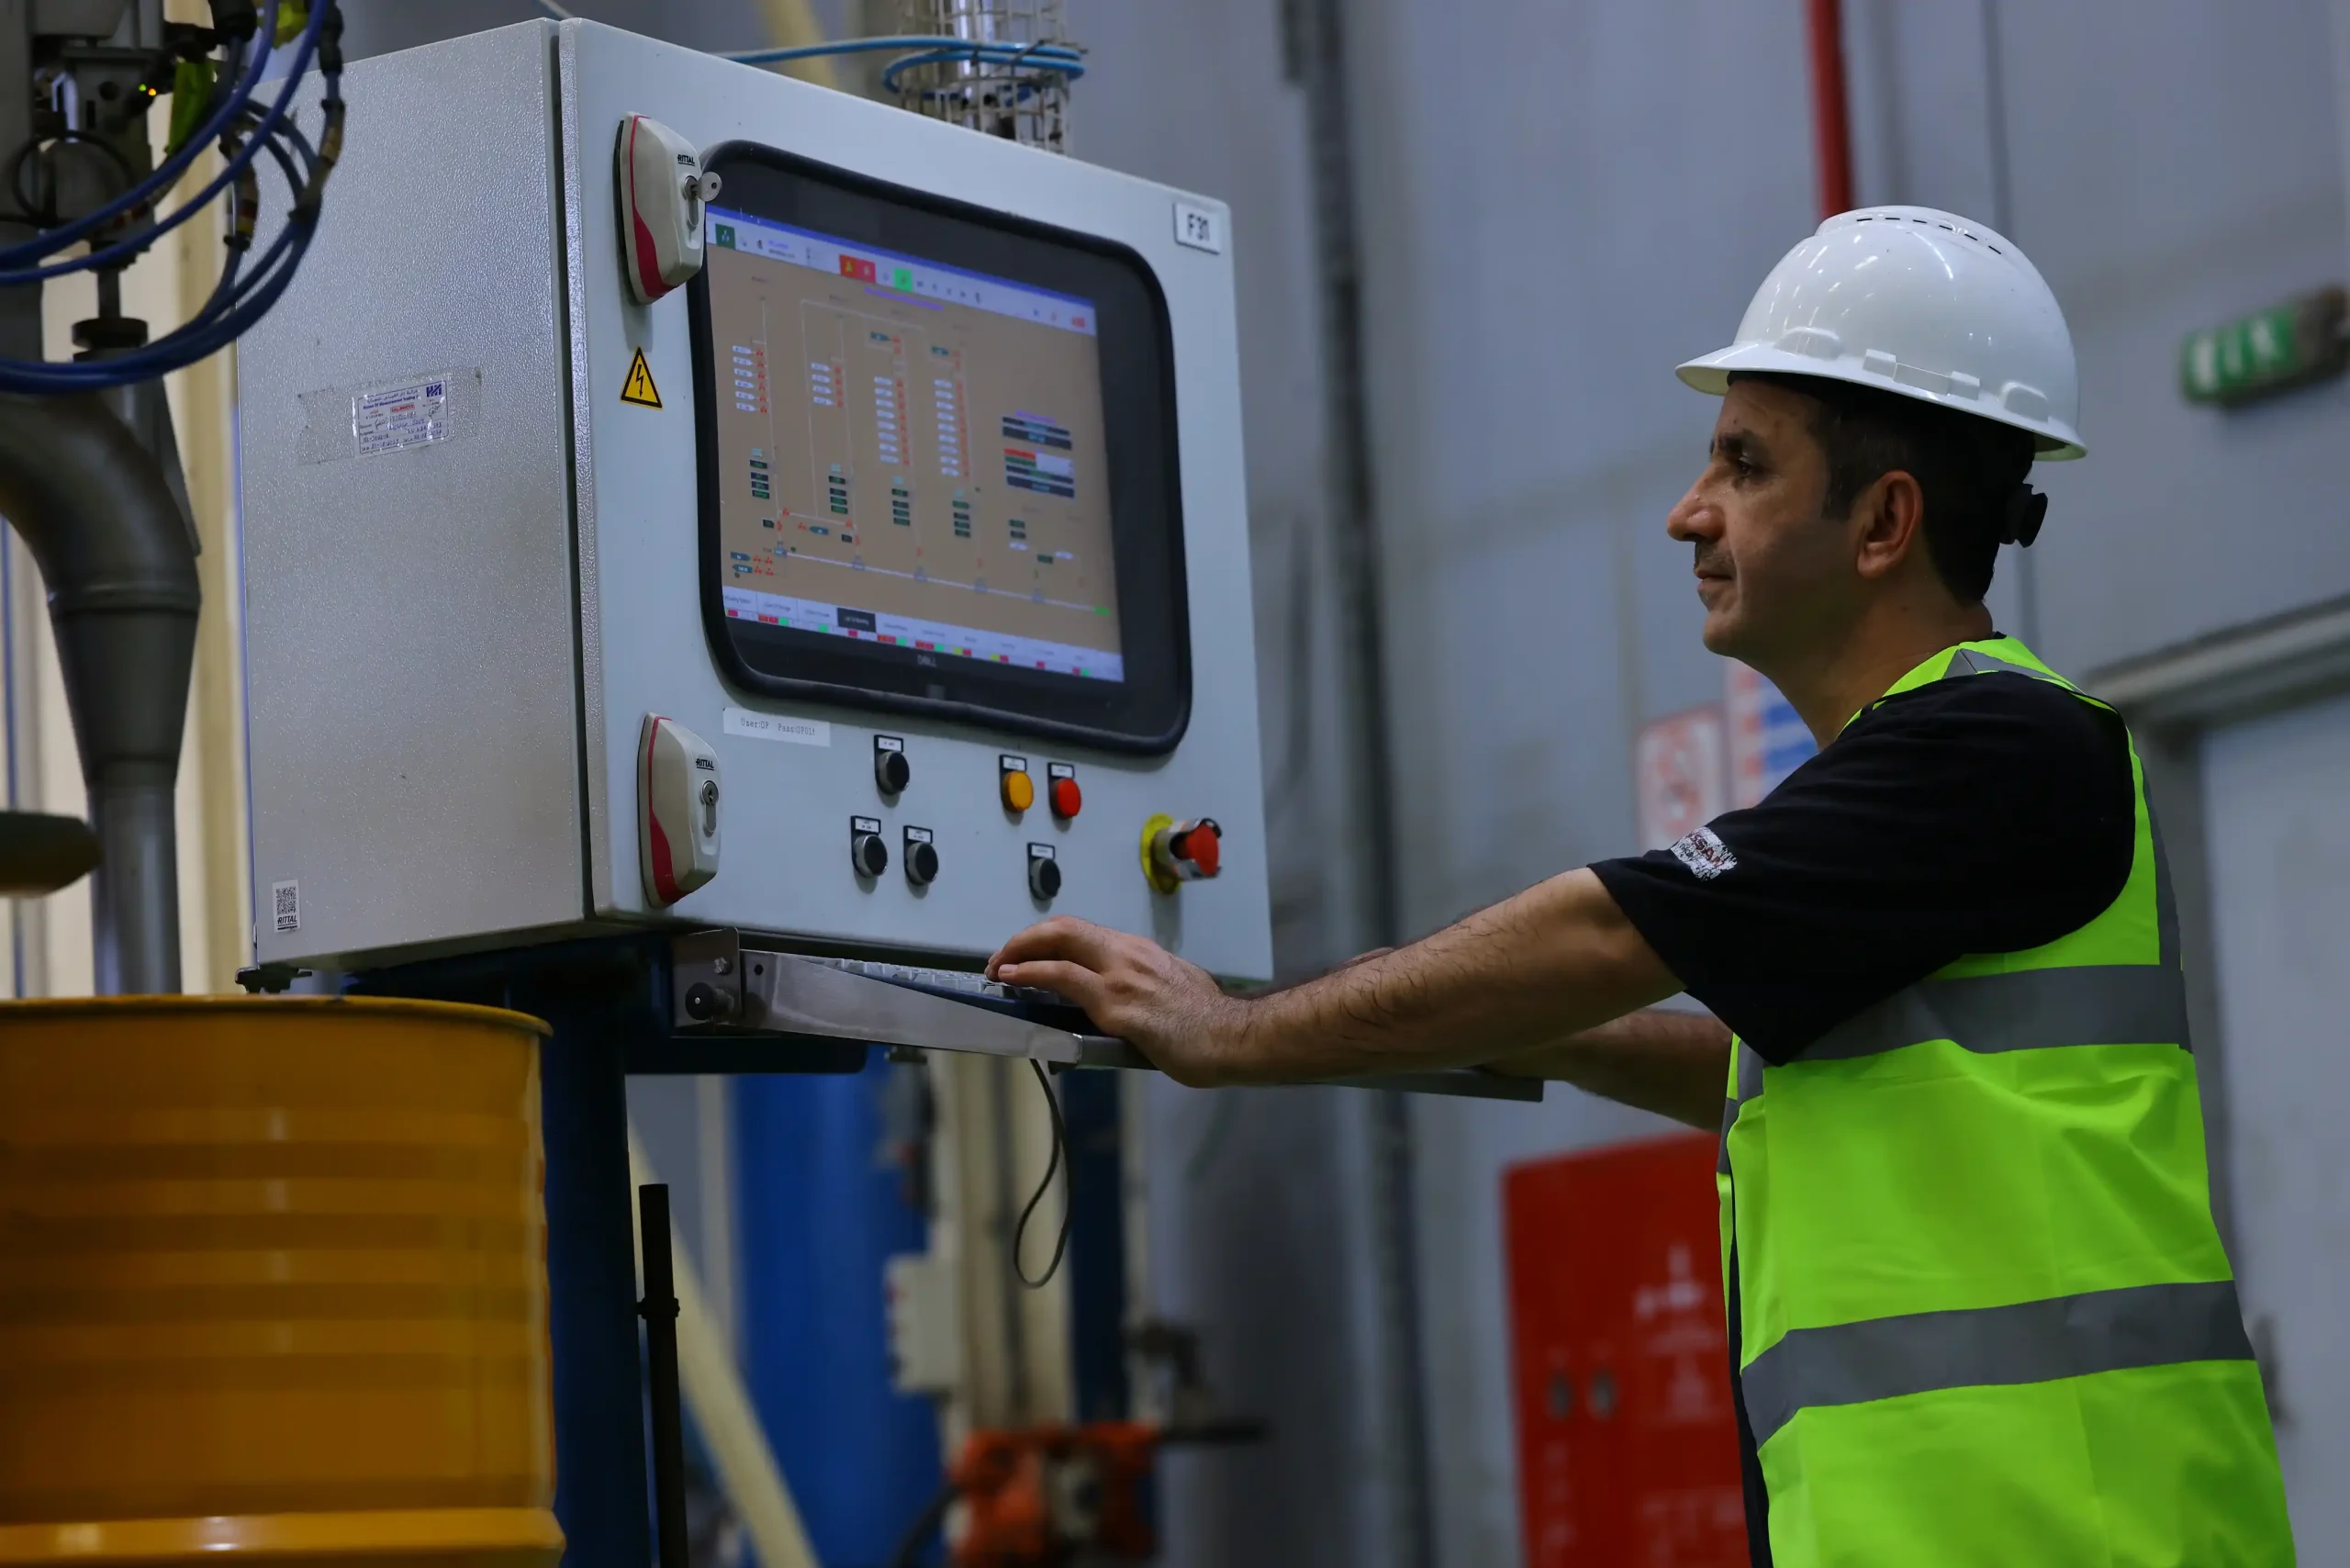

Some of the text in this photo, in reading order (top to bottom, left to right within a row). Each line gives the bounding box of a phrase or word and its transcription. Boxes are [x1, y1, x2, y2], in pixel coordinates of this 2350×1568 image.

[677, 154, 695, 165] RITTAL
[696, 758, 714, 769] RITTAL
[277, 915, 297, 925] RITTAL
